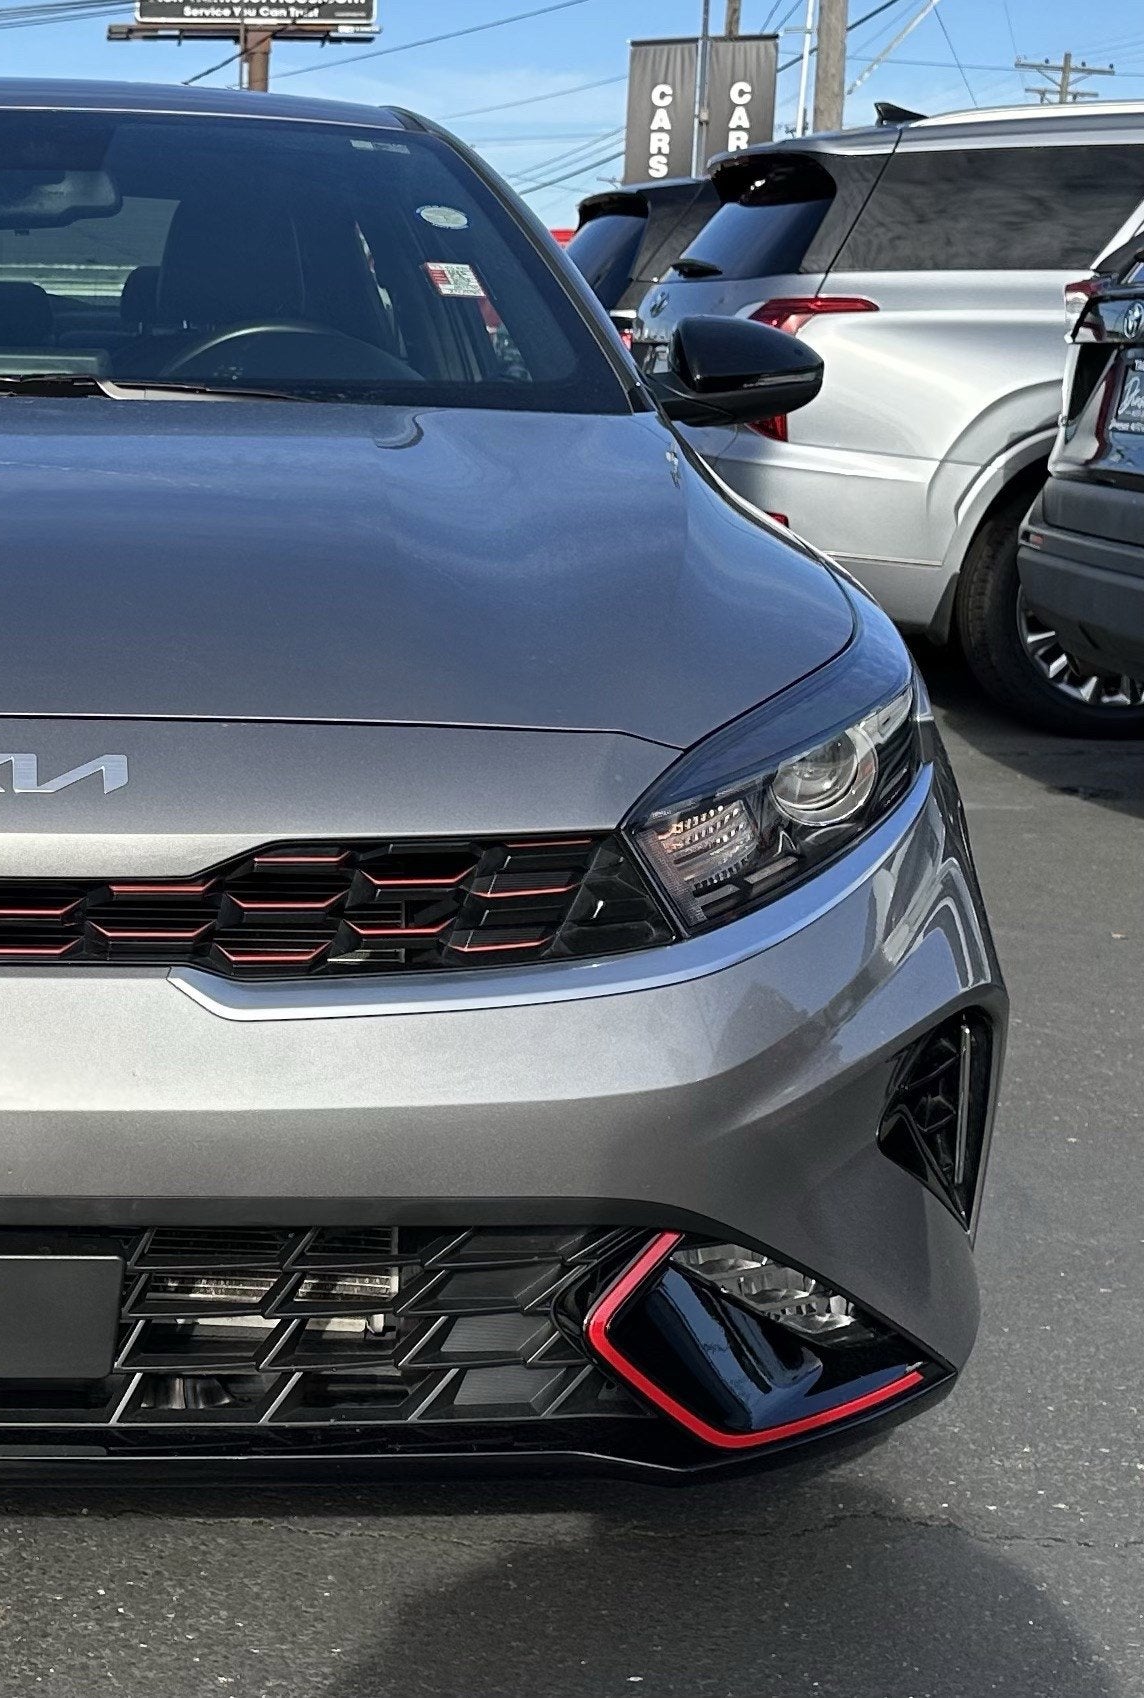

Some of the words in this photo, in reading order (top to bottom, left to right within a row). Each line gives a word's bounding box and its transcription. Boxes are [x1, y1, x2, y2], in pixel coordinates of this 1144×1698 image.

[183, 6, 231, 17] Service
[259, 6, 287, 17] Can
[648, 83, 673, 178] CARS
[728, 81, 752, 152] CAR
